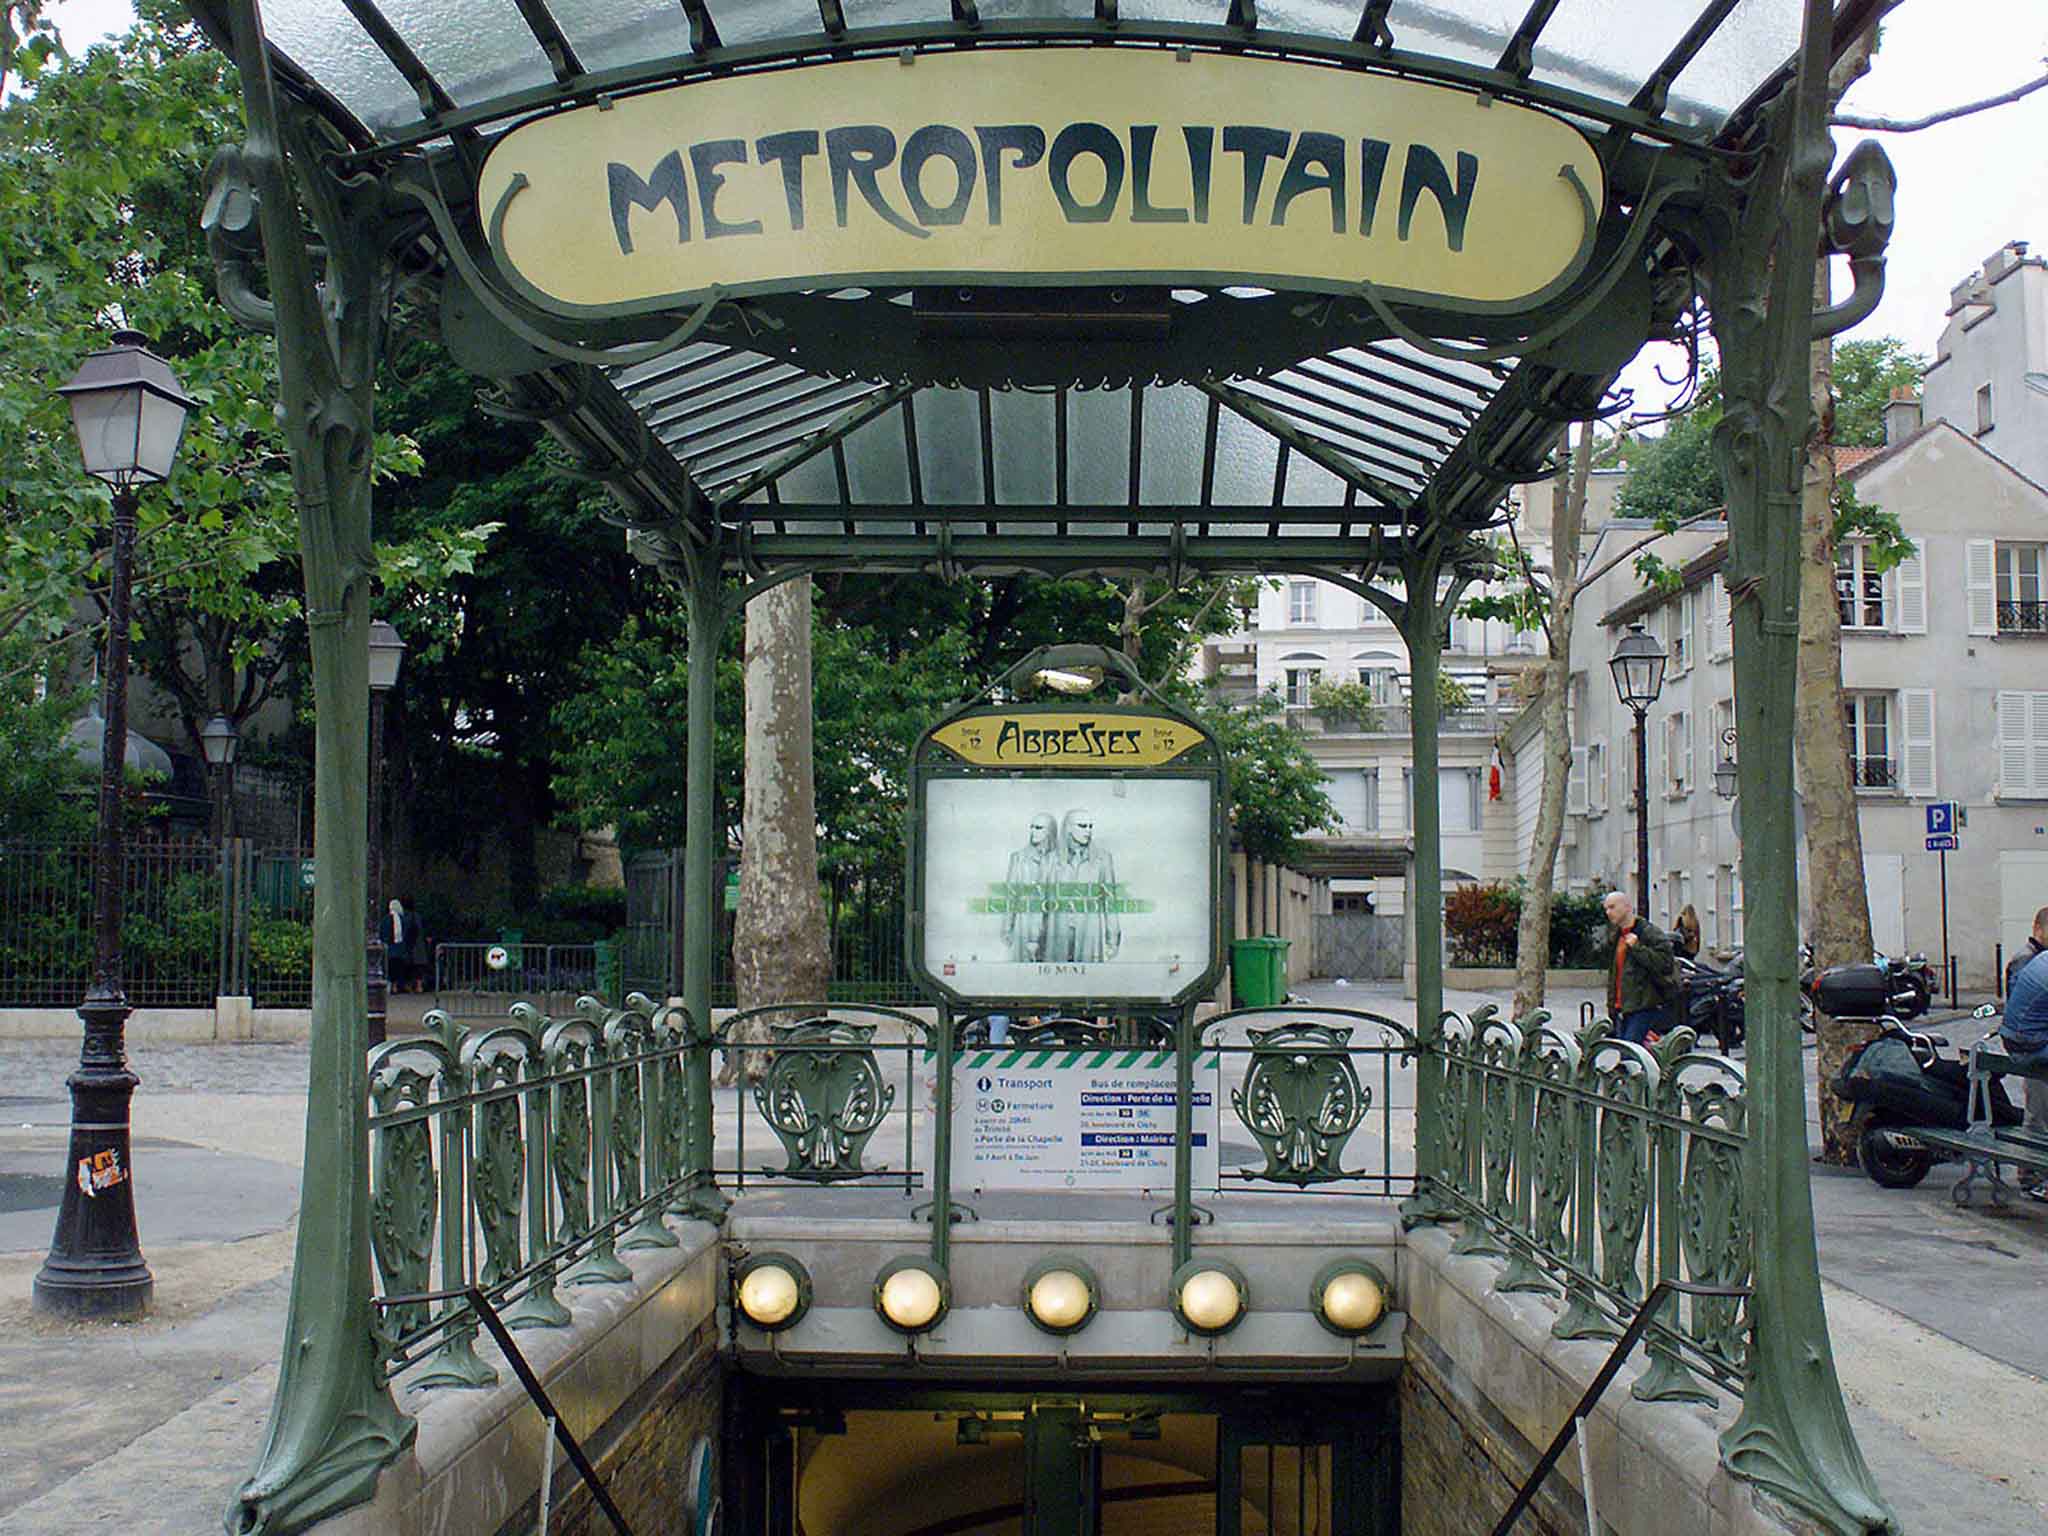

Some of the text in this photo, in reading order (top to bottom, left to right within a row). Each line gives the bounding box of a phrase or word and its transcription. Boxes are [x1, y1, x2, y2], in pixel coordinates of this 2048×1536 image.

[607, 123, 1478, 255] METROPOLITAIN
[996, 720, 1141, 759] ABBESSES
[1932, 809, 1945, 829] P
[998, 1078, 1053, 1090] Transport
[1082, 1094, 1121, 1103] Direction
[1127, 1094, 1151, 1103] Porte
[1027, 1135, 1063, 1143] Chapelle
[1095, 1135, 1135, 1143] Direction
